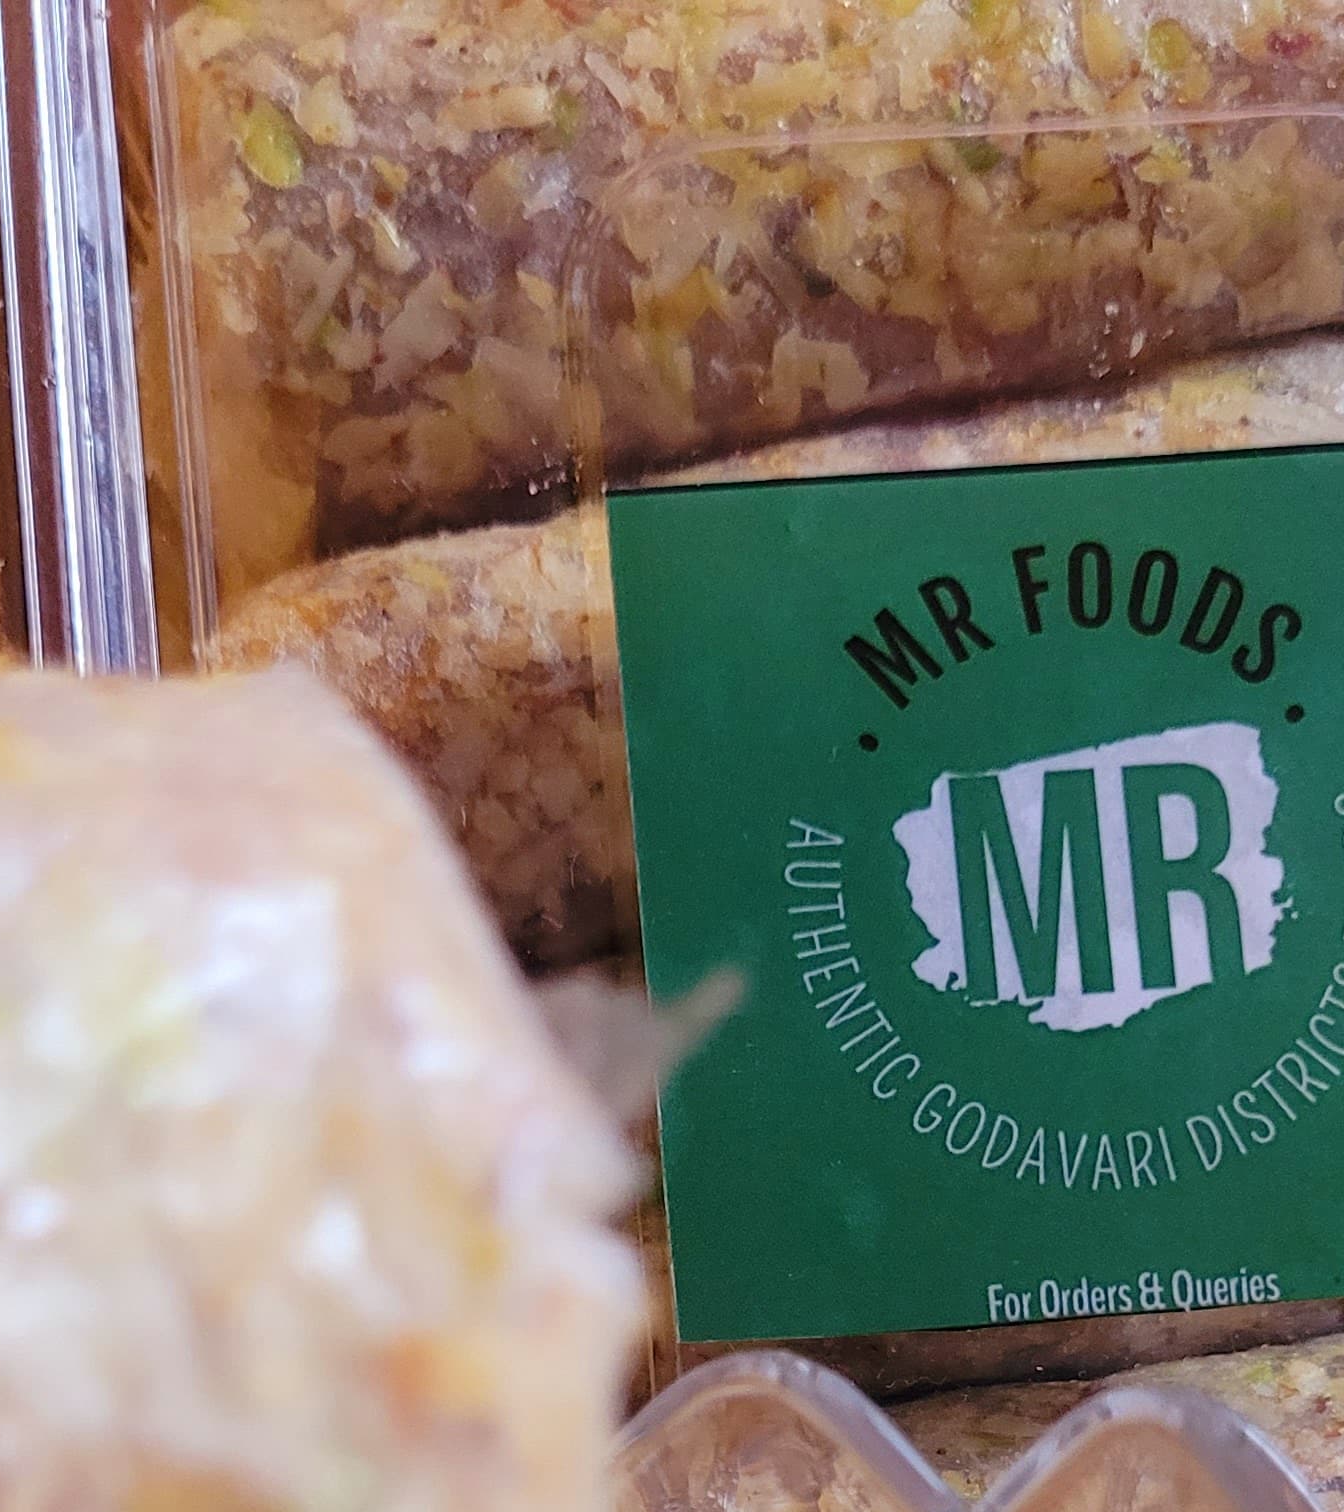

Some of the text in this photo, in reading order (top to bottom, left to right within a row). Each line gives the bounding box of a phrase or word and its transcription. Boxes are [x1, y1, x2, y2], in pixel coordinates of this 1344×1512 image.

[842, 541, 1303, 710] MR FOODS
[946, 761, 1245, 1000] MR
[783, 818, 921, 1103] AUTHENTIC
[914, 1082, 1176, 1191] GODAVARI
[987, 1267, 1281, 1323] For Orders & Queries
